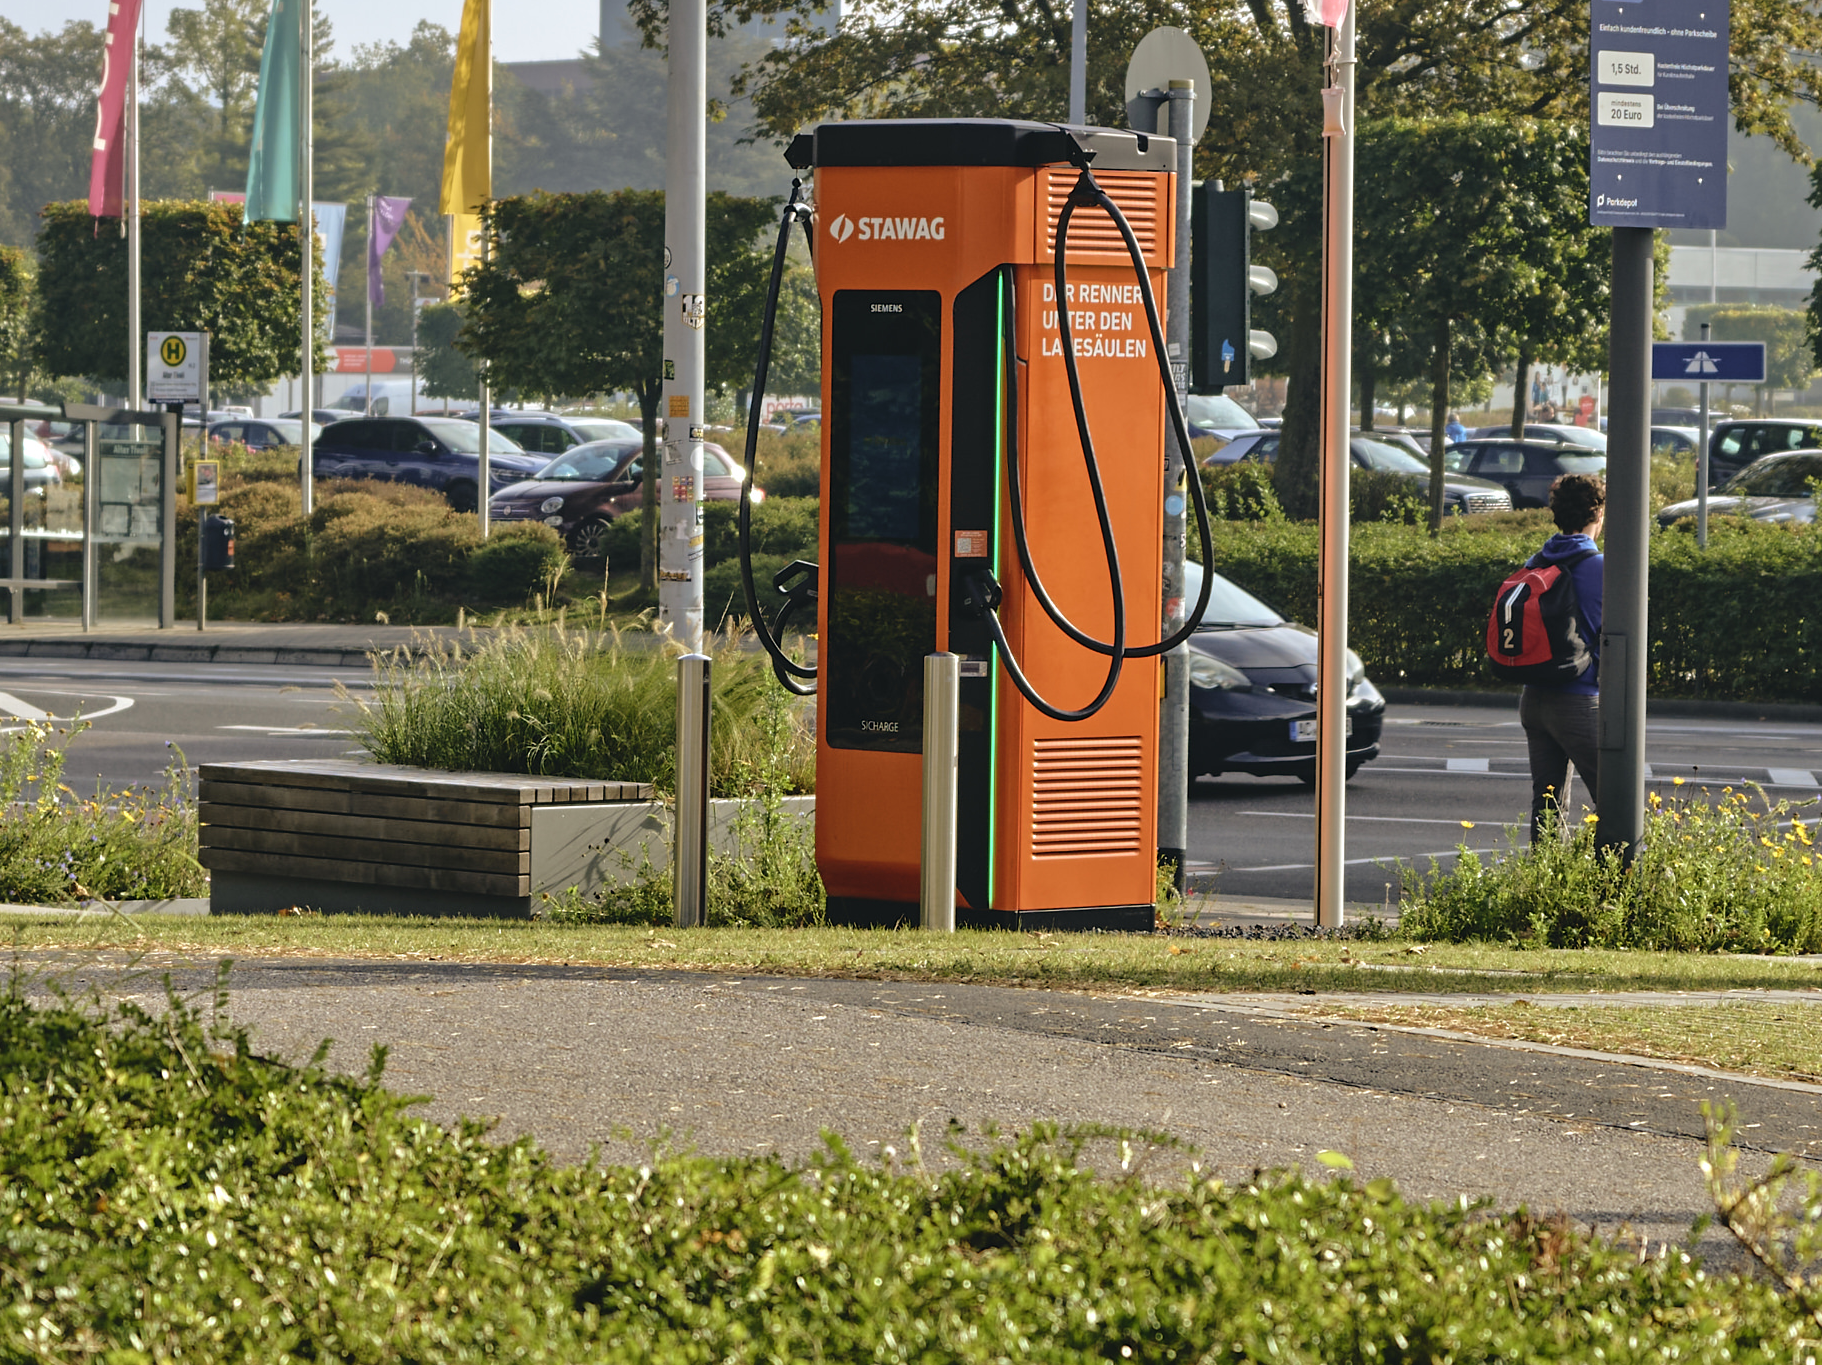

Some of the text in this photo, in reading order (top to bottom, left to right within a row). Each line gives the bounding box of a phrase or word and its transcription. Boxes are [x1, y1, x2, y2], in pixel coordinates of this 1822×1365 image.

[1611, 62, 1642, 75] 1,5 Std.
[1611, 108, 1642, 121] 20 Euro
[1606, 197, 1638, 209] Parkdepot
[858, 217, 945, 240] STAWAG
[1043, 283, 1144, 304] DR RENNER
[870, 304, 903, 313] SIEMENS
[1100, 311, 1132, 331] DEN
[167, 342, 180, 360] H
[1042, 333, 1146, 358] LAESÄULEN
[1503, 628, 1515, 649] 2
[861, 719, 899, 733] SICHARGE
